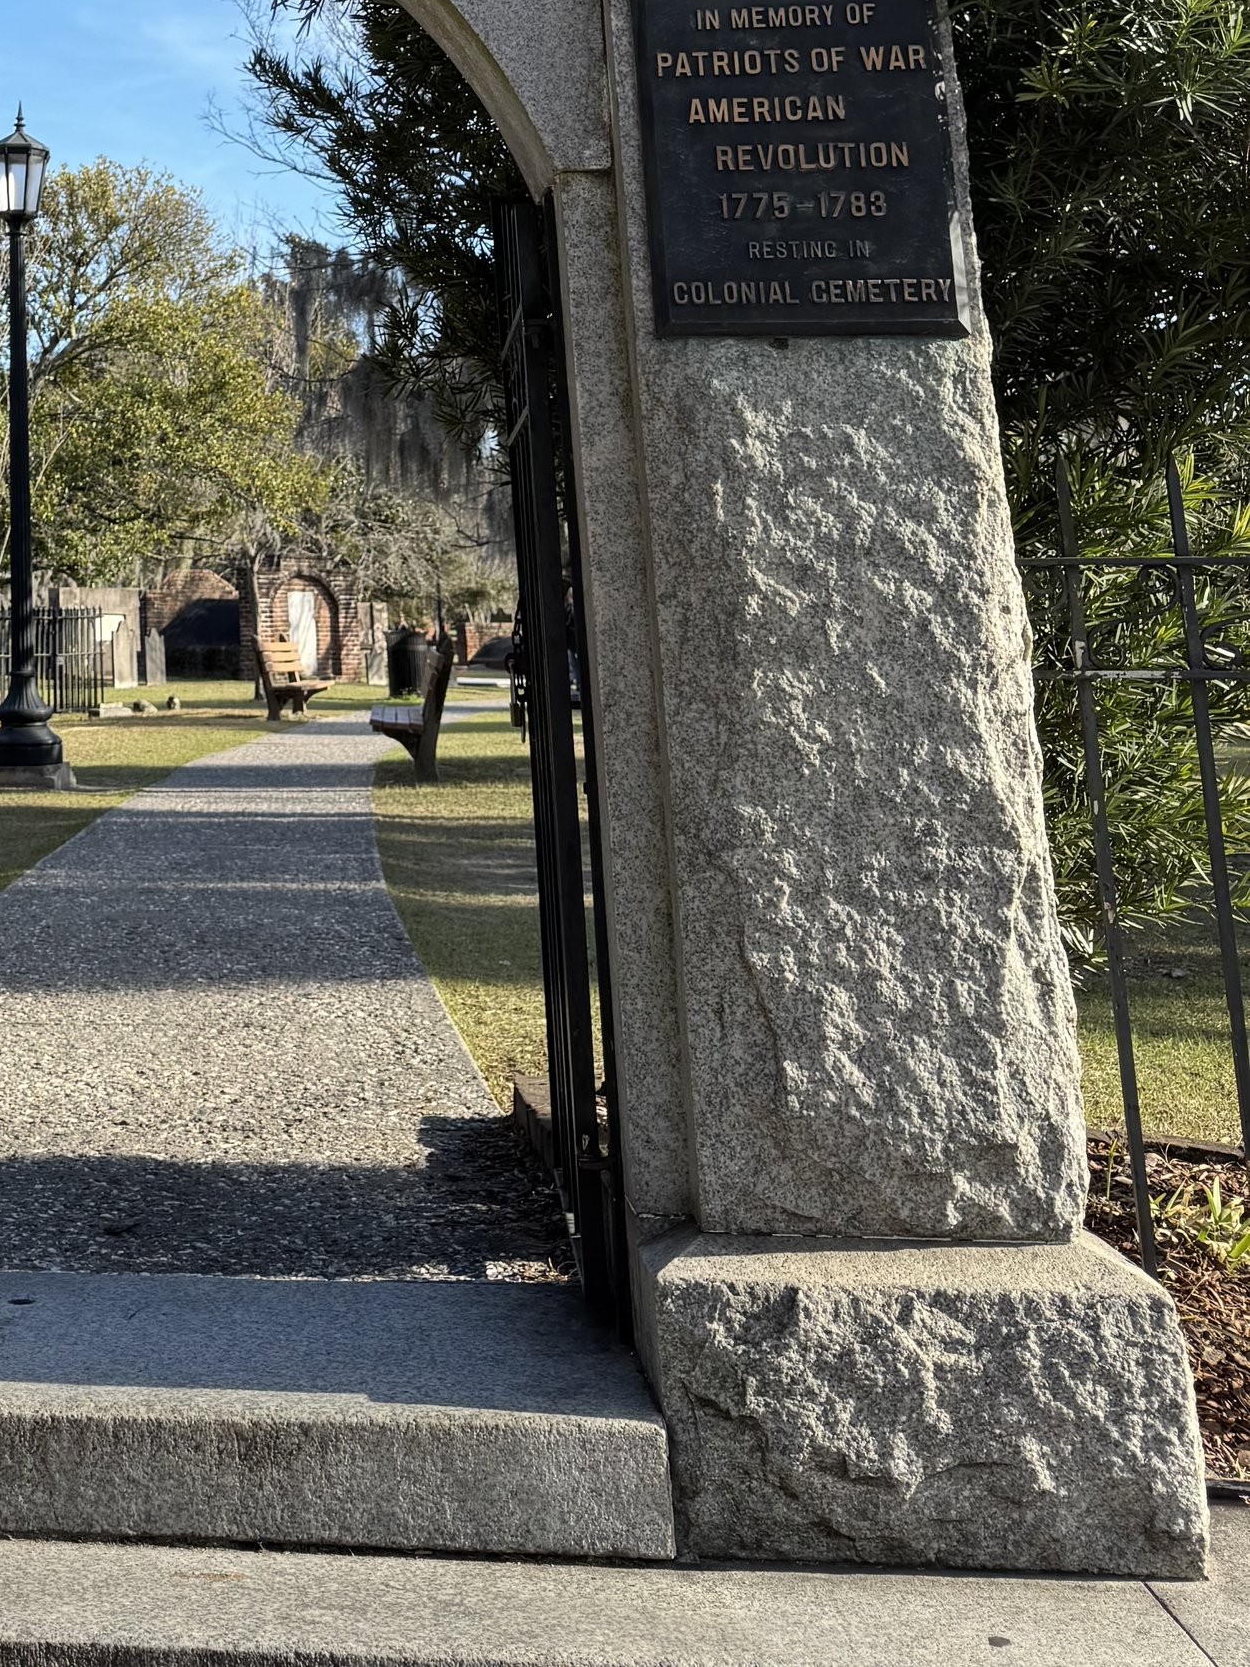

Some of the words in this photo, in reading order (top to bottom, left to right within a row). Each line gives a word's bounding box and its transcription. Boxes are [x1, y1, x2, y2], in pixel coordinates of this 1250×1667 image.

[696, 8, 720, 31] IN
[730, 5, 835, 29] MEMORY
[846, 2, 876, 25] OF
[656, 48, 800, 77] PATRIOTS
[810, 46, 846, 73] OF
[859, 44, 928, 71] WAR
[688, 94, 846, 124] AMERICAN
[714, 141, 910, 171] REVOLUTION
[749, 240, 836, 259] RESTING
[849, 239, 870, 258] IN
[673, 280, 800, 305] COLONIAL
[811, 278, 951, 304] CEMETERY
